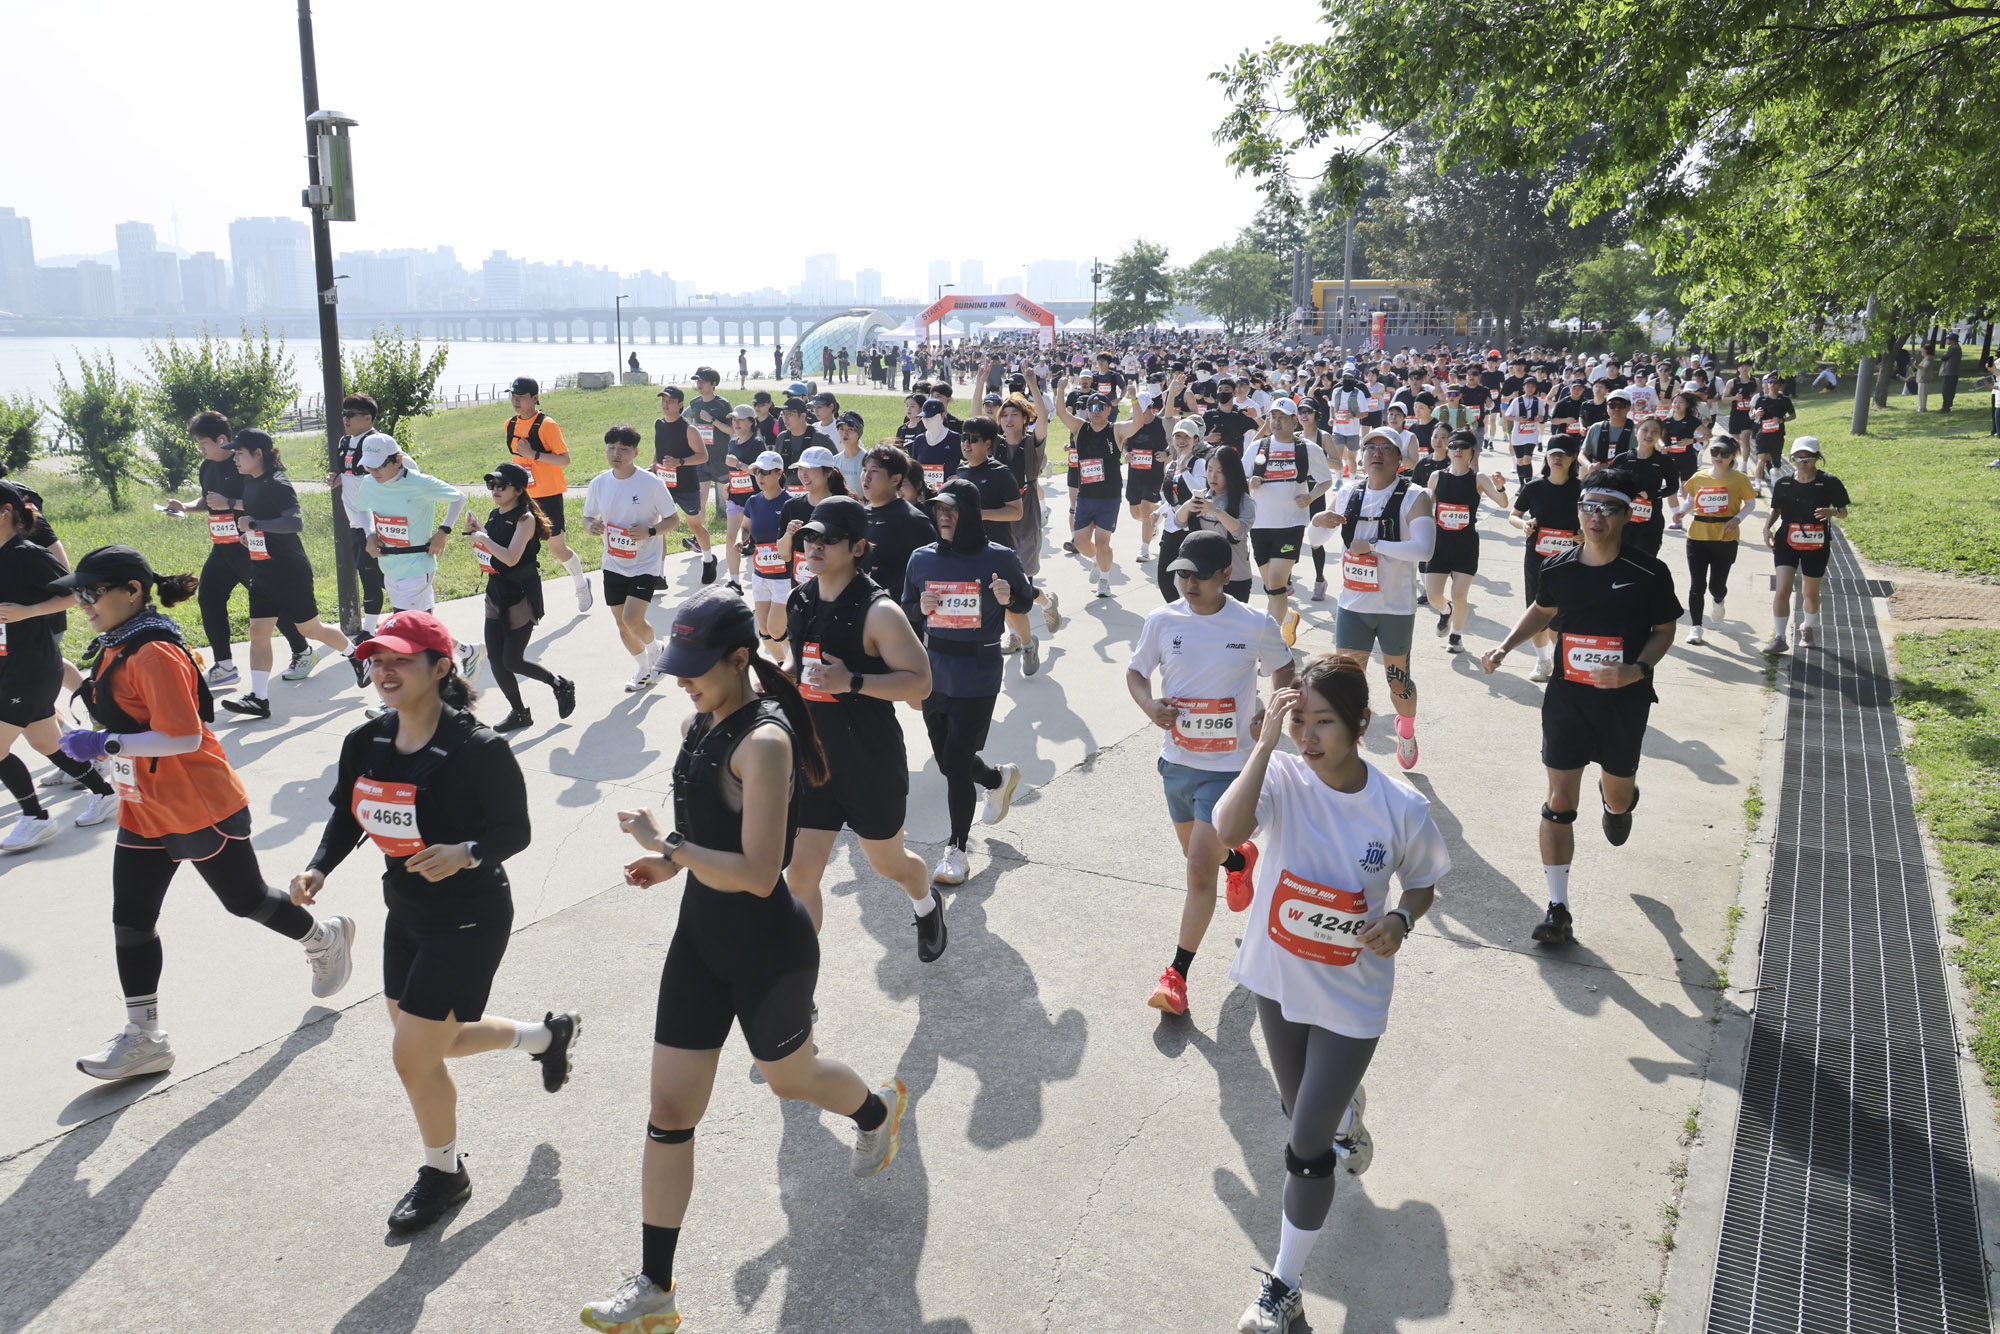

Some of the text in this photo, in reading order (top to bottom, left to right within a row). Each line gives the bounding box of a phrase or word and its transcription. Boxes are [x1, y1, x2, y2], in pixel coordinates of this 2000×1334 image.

[989, 301, 1007, 309] RUN
[1015, 301, 1042, 319] FINISH
[922, 302, 944, 320] START
[1633, 505, 1651, 514] 4314
[1448, 512, 1468, 520] 4186
[216, 524, 236, 532] 2412
[385, 525, 407, 535] 1992
[617, 536, 636, 546] 1512
[1550, 539, 1572, 547] 4423
[1351, 566, 1375, 577] 2611
[946, 597, 977, 608] 1943
[1572, 652, 1621, 664] M 2542
[1181, 717, 1233, 730] M 1966
[361, 808, 413, 827] W 4663
[1364, 848, 1387, 865] 10K
[1282, 877, 1318, 895] BURNING
[1318, 890, 1338, 900] RUN
[1287, 907, 1366, 936] W 4248
